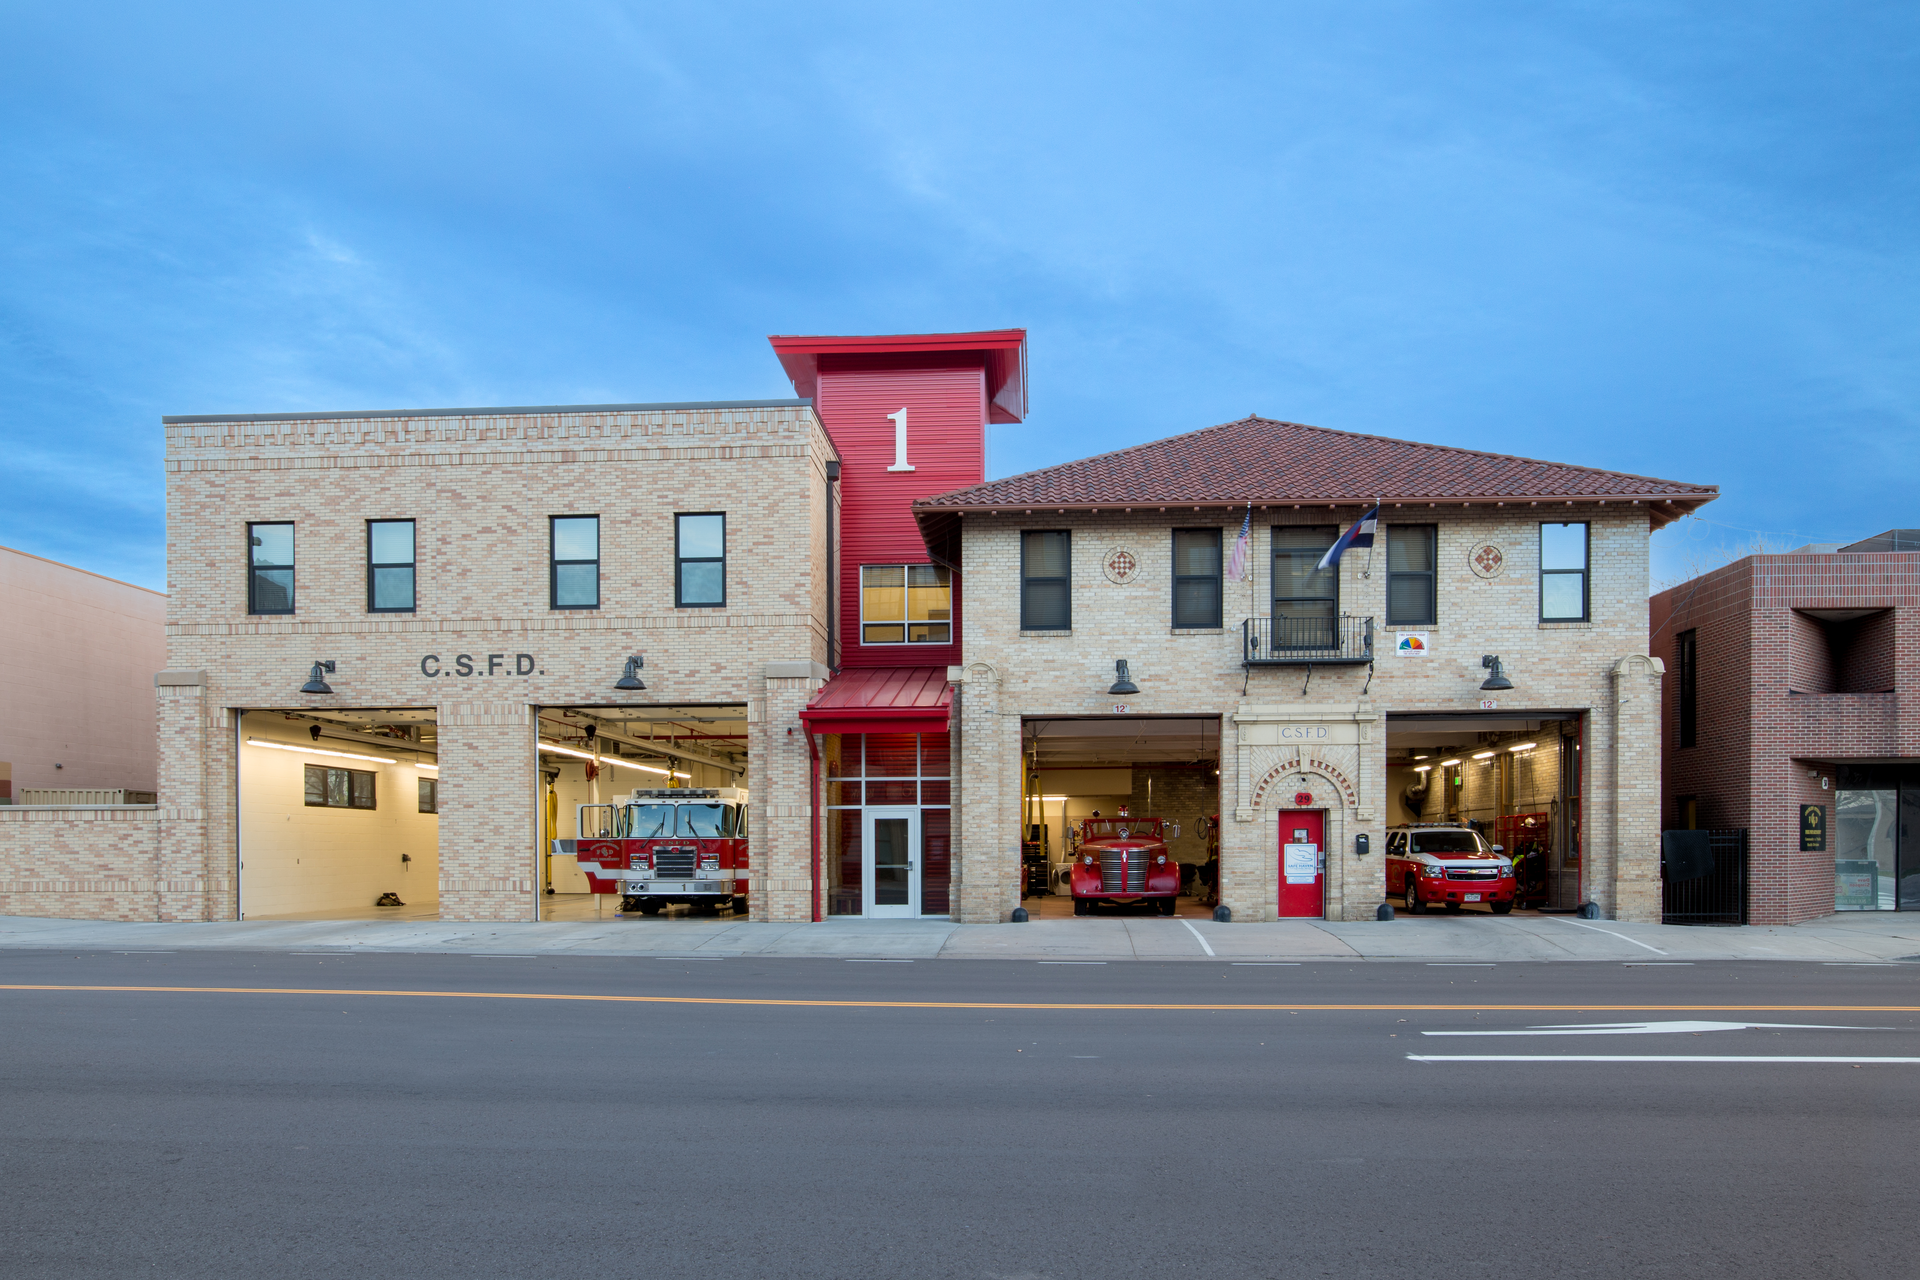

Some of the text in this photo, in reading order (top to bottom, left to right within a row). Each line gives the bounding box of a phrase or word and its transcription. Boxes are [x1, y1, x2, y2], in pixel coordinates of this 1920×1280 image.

[887, 407, 916, 472] 1
[421, 654, 545, 678] C.S.F.D.
[1298, 795, 1310, 803] 29
